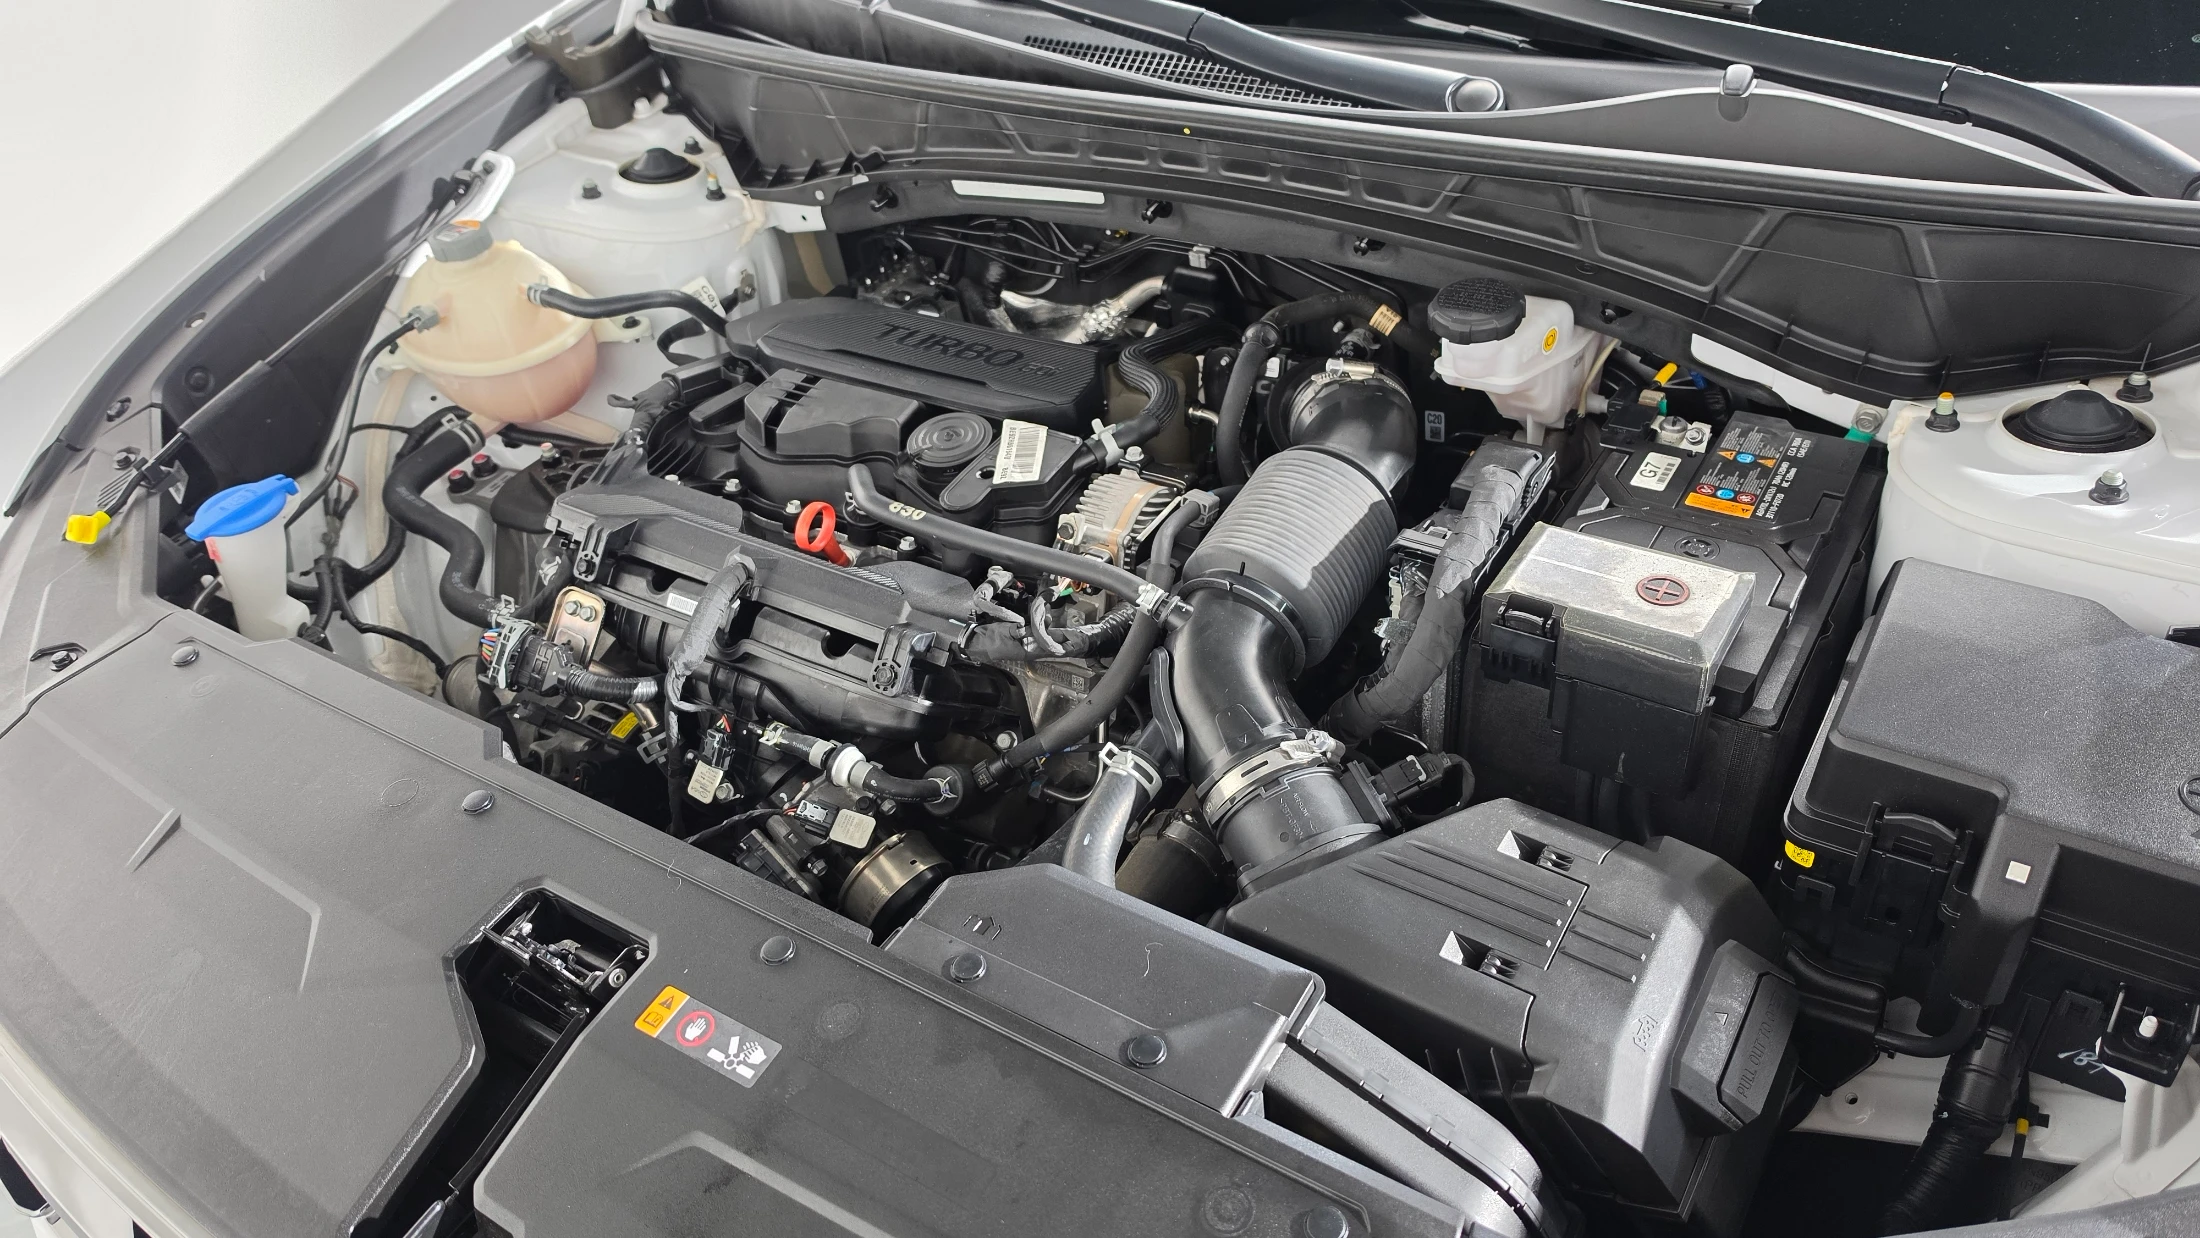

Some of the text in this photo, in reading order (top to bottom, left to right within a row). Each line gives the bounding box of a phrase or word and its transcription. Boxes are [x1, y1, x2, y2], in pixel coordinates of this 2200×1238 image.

[874, 323, 1025, 367] TURBO
[1427, 413, 1443, 425] C20
[1640, 461, 1661, 478] G7
[888, 501, 927, 521] 830
[1737, 1068, 1756, 1098] PULL
[1749, 1039, 1765, 1065] OUT
[1758, 1021, 1775, 1040] TO
